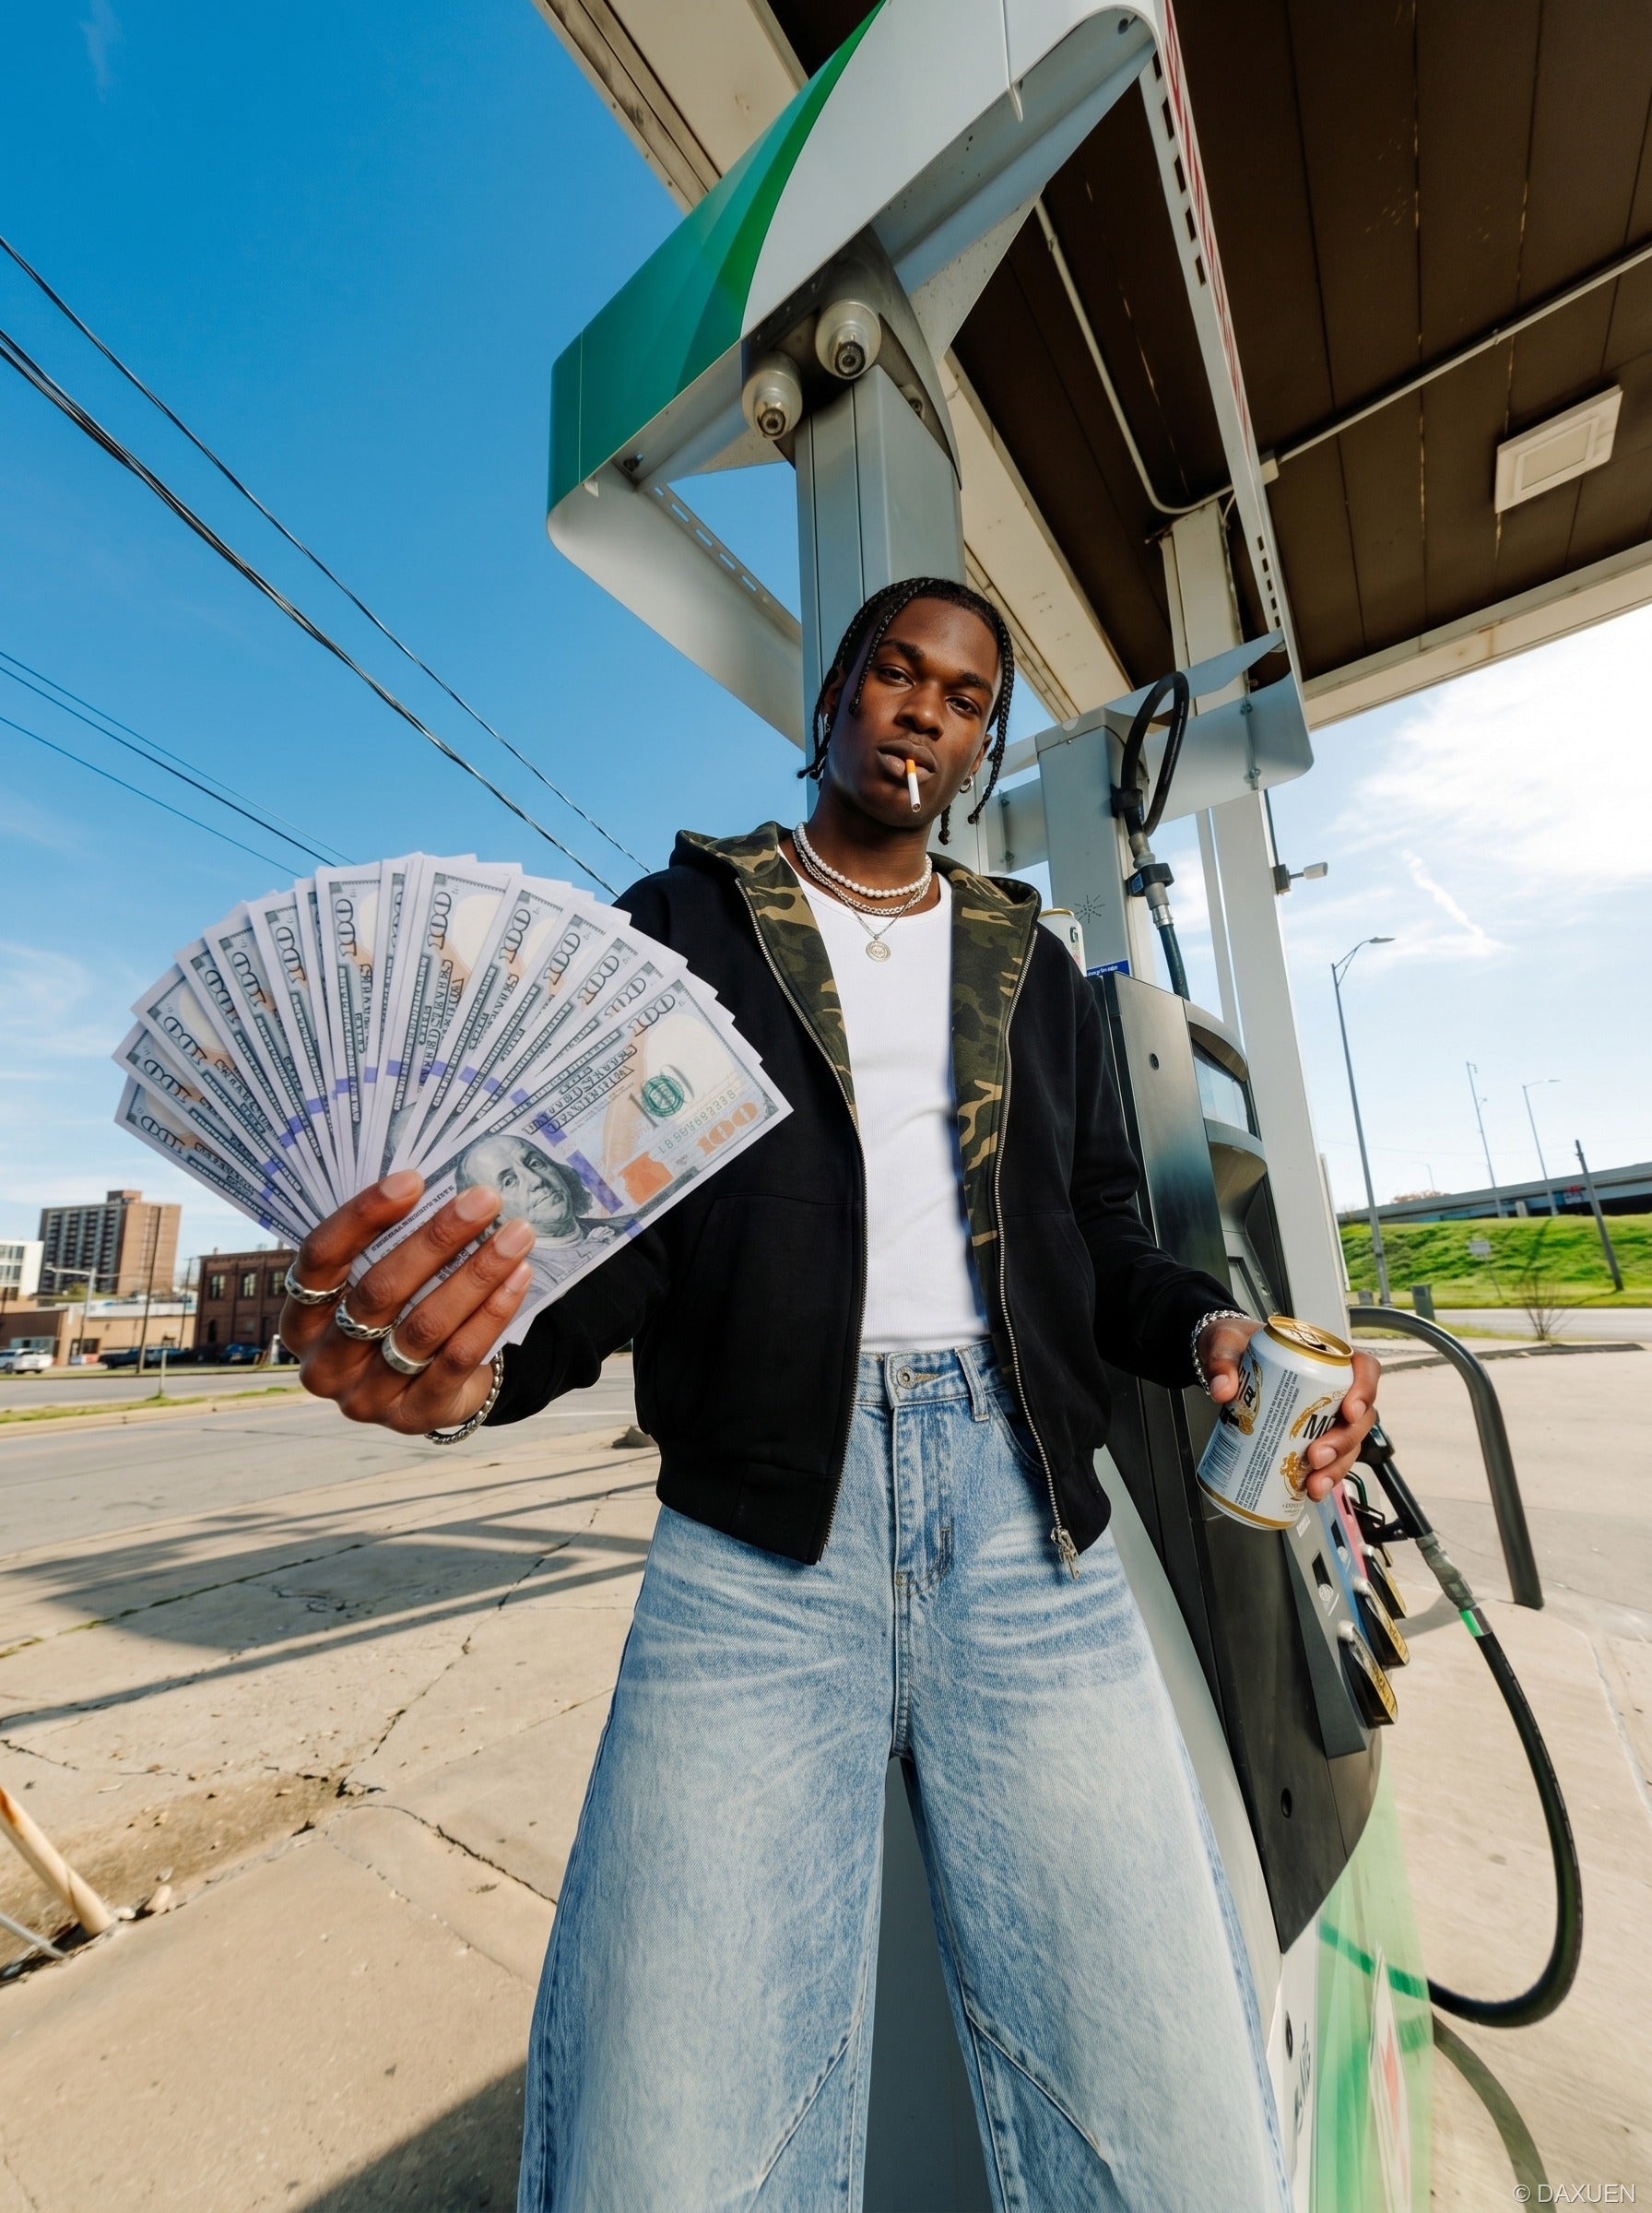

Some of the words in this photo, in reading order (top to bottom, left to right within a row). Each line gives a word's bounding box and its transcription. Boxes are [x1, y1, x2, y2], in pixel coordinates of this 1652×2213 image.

[336, 898, 358, 955] 100
[428, 892, 452, 949] 100
[499, 908, 531, 964] 100
[232, 952, 266, 1007] 100
[276, 926, 306, 983] 100
[542, 931, 580, 985] 100
[579, 955, 619, 1005] 100
[164, 1016, 207, 1064] 100
[631, 993, 676, 1035] 100
[145, 1059, 192, 1106] 100
[140, 1115, 185, 1154] 100
[696, 1102, 759, 1156] 100
